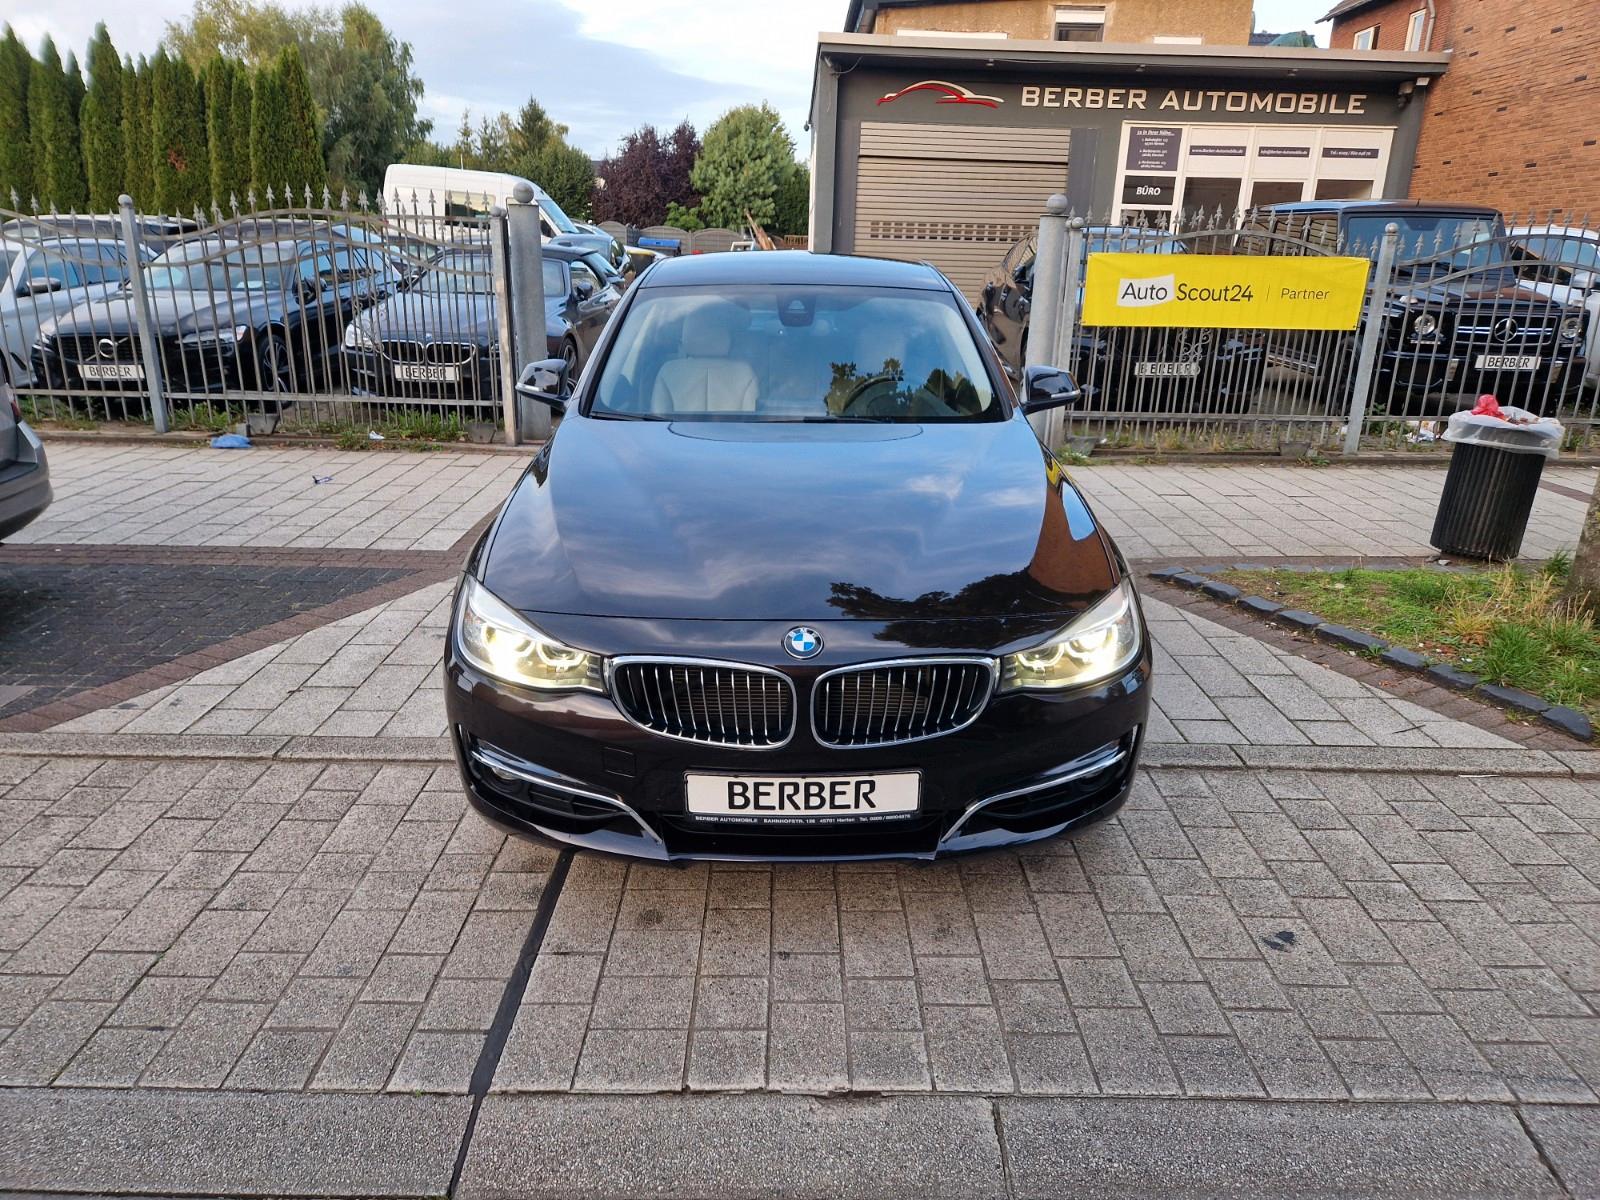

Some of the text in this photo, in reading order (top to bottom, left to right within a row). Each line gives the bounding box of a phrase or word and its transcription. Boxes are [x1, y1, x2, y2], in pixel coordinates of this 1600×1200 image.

[1021, 86, 1367, 116] BERBER AUTOMOBILE
[1136, 185, 1161, 195] BÜRO
[1121, 282, 1330, 303] Auto Scout24 Partner
[727, 779, 877, 811] BERBER
